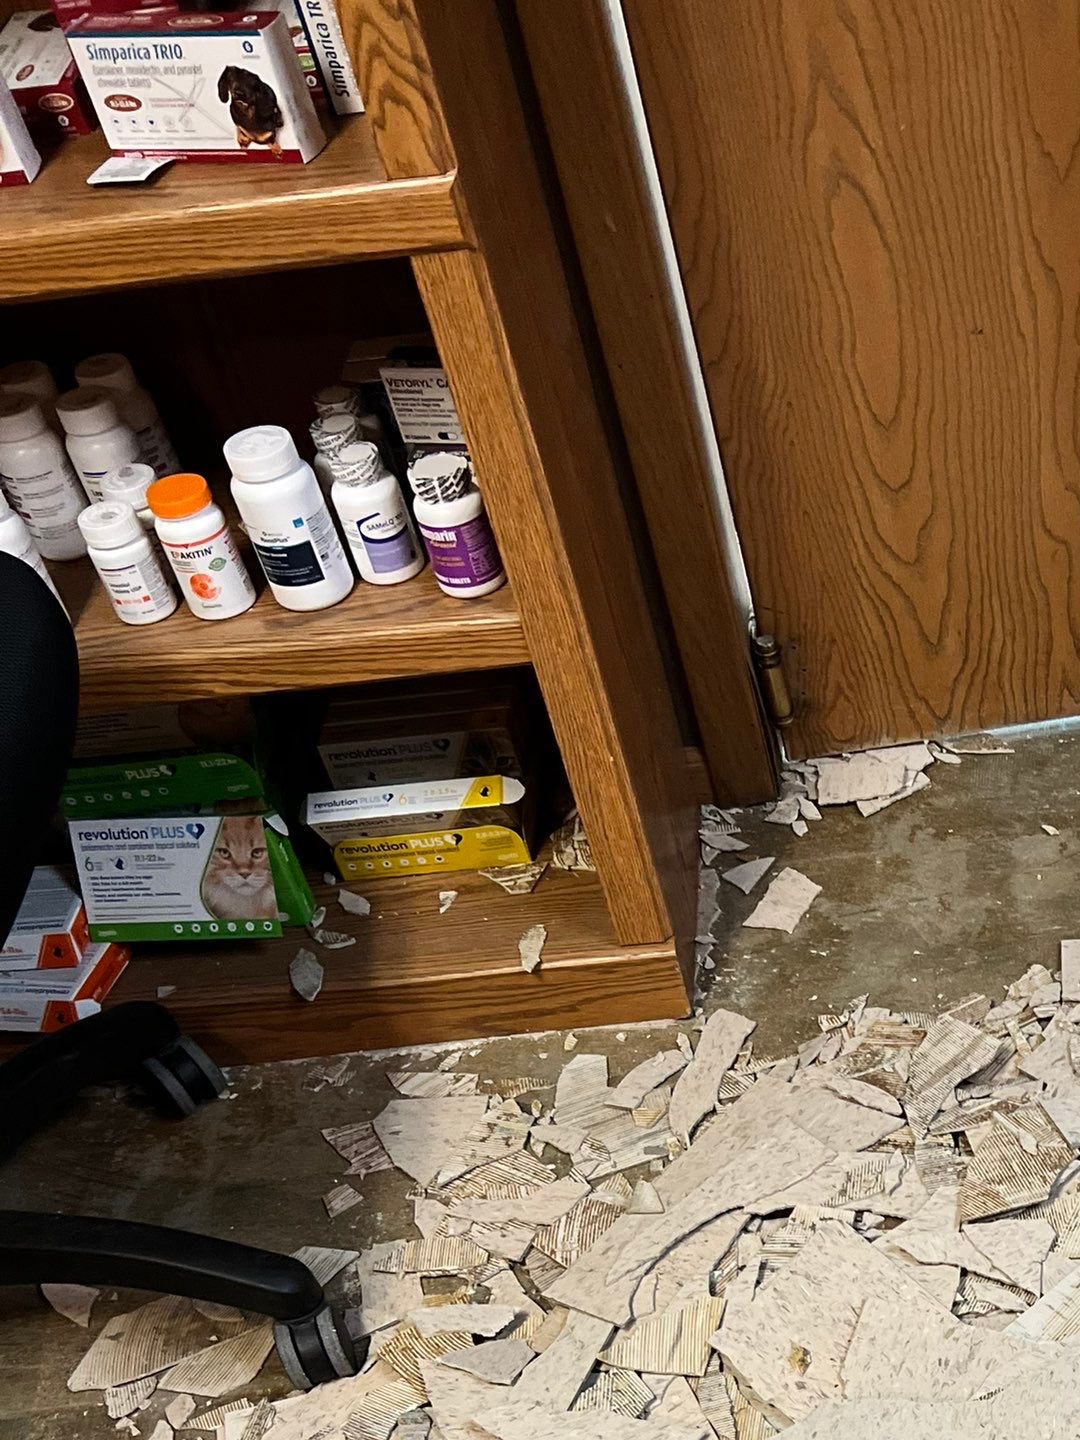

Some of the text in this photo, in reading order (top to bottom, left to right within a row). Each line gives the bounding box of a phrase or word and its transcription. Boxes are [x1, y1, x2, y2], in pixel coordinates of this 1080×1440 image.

[86, 43, 184, 64] Simparica TRIO
[315, 23, 351, 98] Simparica
[385, 377, 432, 388] VETORYL
[170, 547, 213, 561] EPAKITIN
[327, 744, 398, 762] revolution
[399, 741, 432, 754] PLUS
[125, 767, 161, 781] PLUS
[313, 797, 359, 810] revolution
[359, 796, 382, 805] PLUS
[78, 823, 186, 842] revolution PLUS
[338, 834, 445, 855] revolution PLUS
[84, 855, 95, 872] 6
